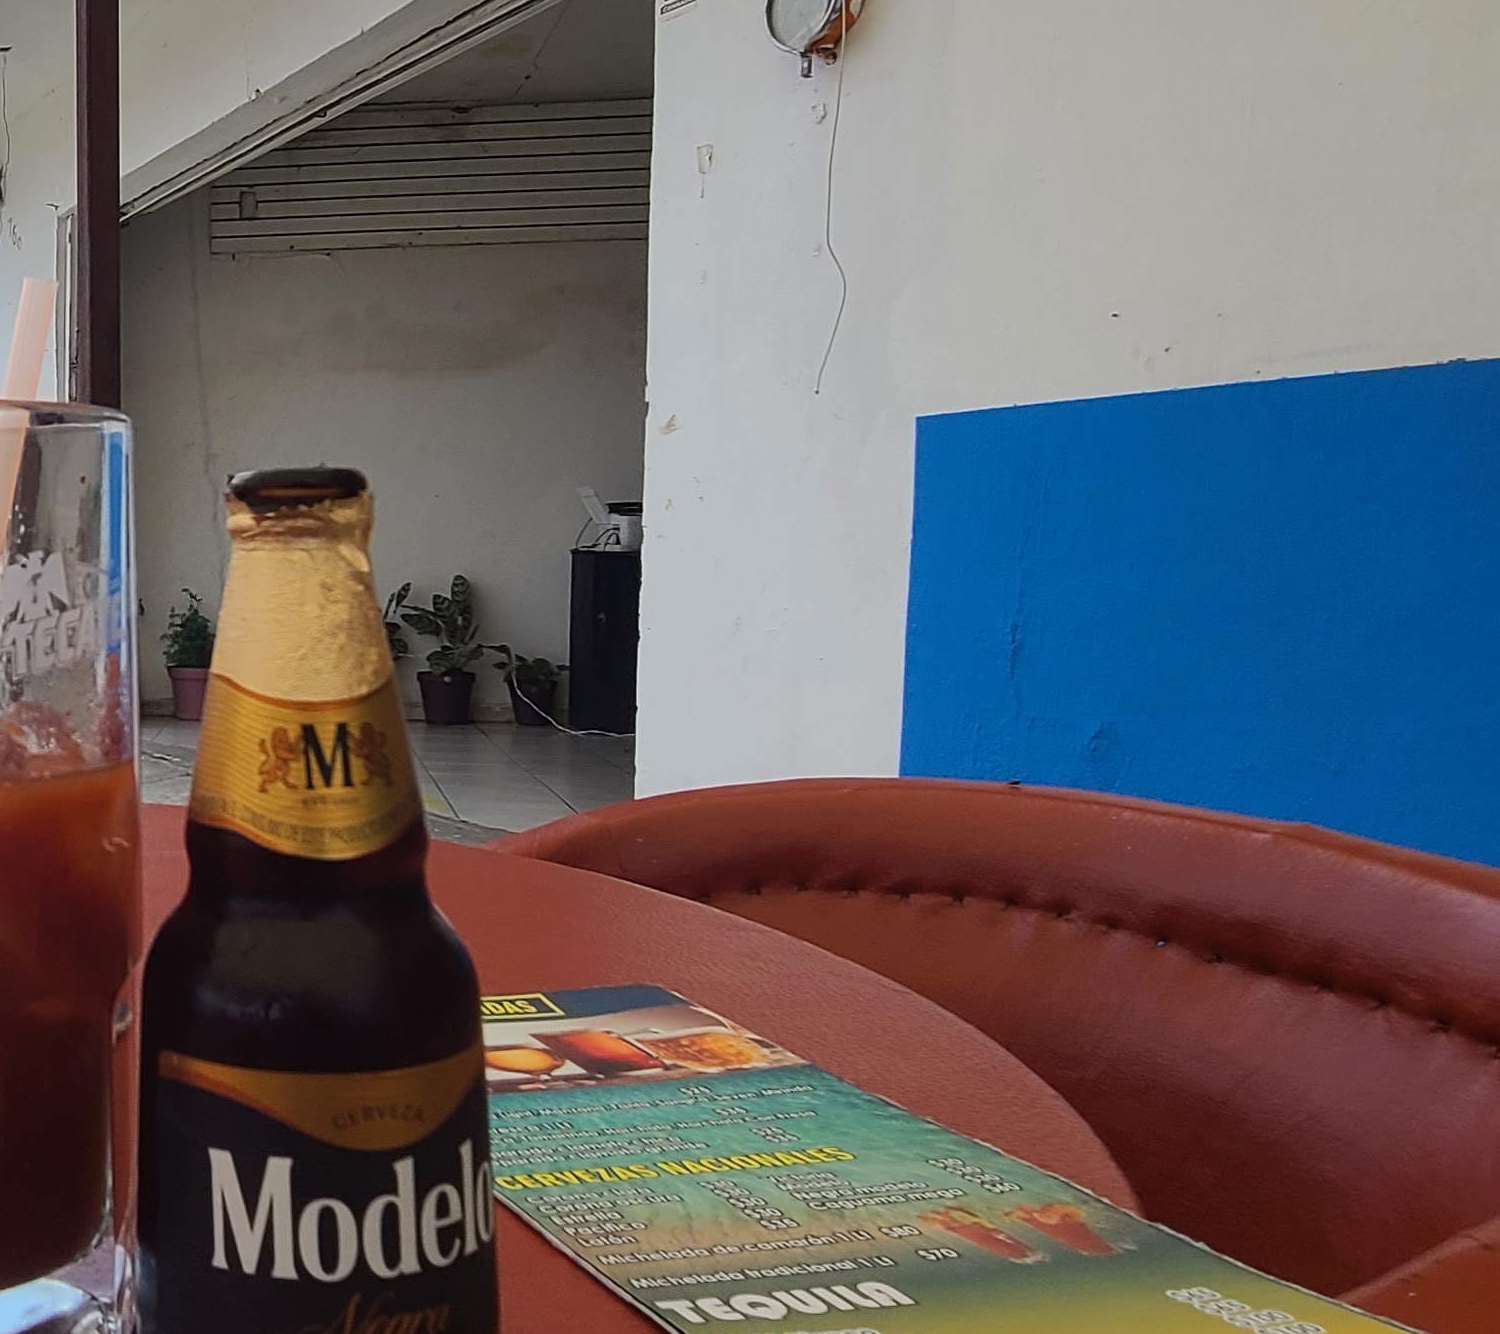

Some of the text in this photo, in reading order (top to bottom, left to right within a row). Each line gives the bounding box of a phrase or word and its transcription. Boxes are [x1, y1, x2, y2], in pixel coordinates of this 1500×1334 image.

[300, 722, 355, 791] M
[495, 1147, 855, 1189] CERVEZAS NACIONALES
[207, 1138, 494, 1283] Modelo
[808, 1194, 904, 1209] Caguama
[901, 1188, 963, 1199] mega
[595, 1248, 709, 1264] Michelada
[712, 1245, 741, 1253] de
[744, 1235, 839, 1250] camarón
[630, 1272, 744, 1287] Michelada
[745, 1260, 856, 1278] tradicional
[917, 1248, 957, 1260] $70
[655, 1281, 916, 1323] TEQUILA
